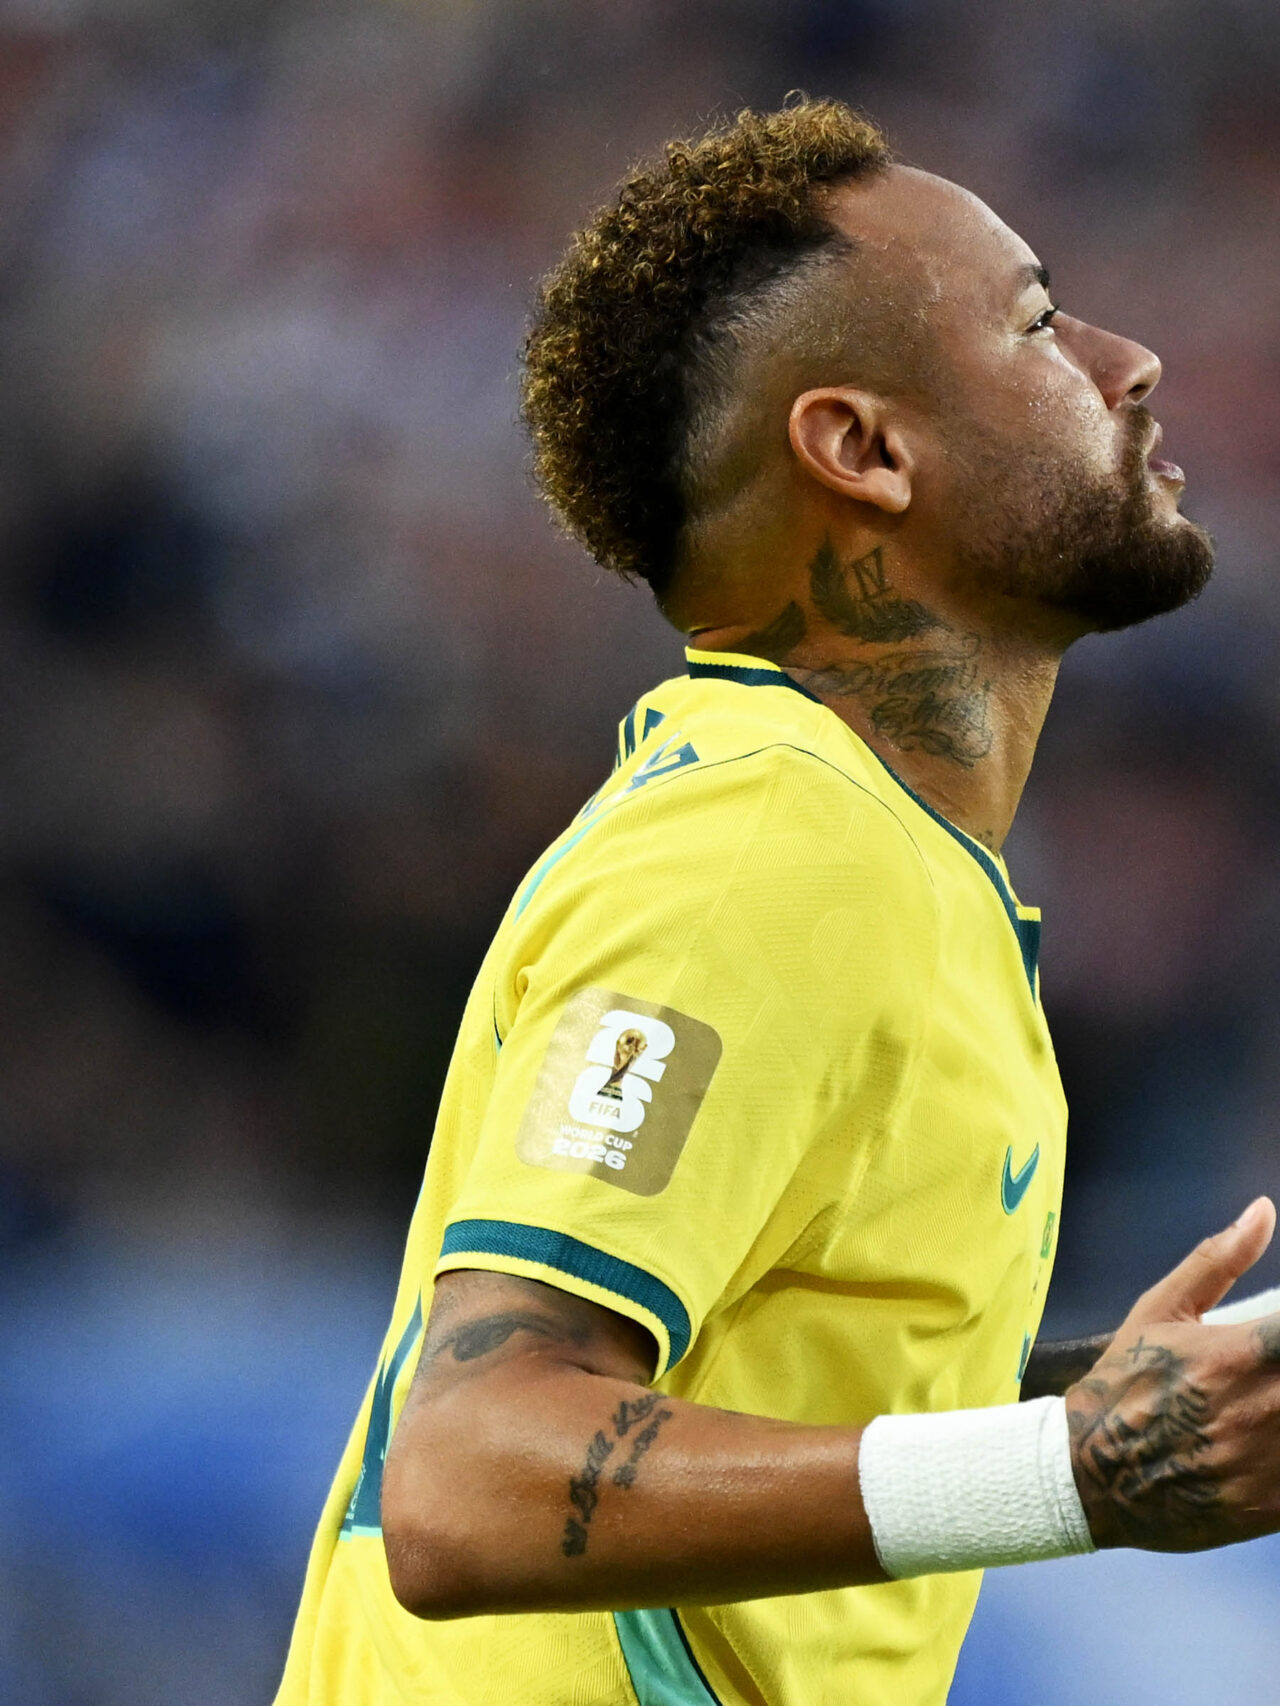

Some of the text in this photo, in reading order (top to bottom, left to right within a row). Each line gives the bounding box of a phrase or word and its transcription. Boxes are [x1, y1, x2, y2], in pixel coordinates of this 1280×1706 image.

[589, 1102, 620, 1119] FIFA
[561, 1125, 632, 1151] WORLD CUP
[553, 1139, 627, 1170] 2026
